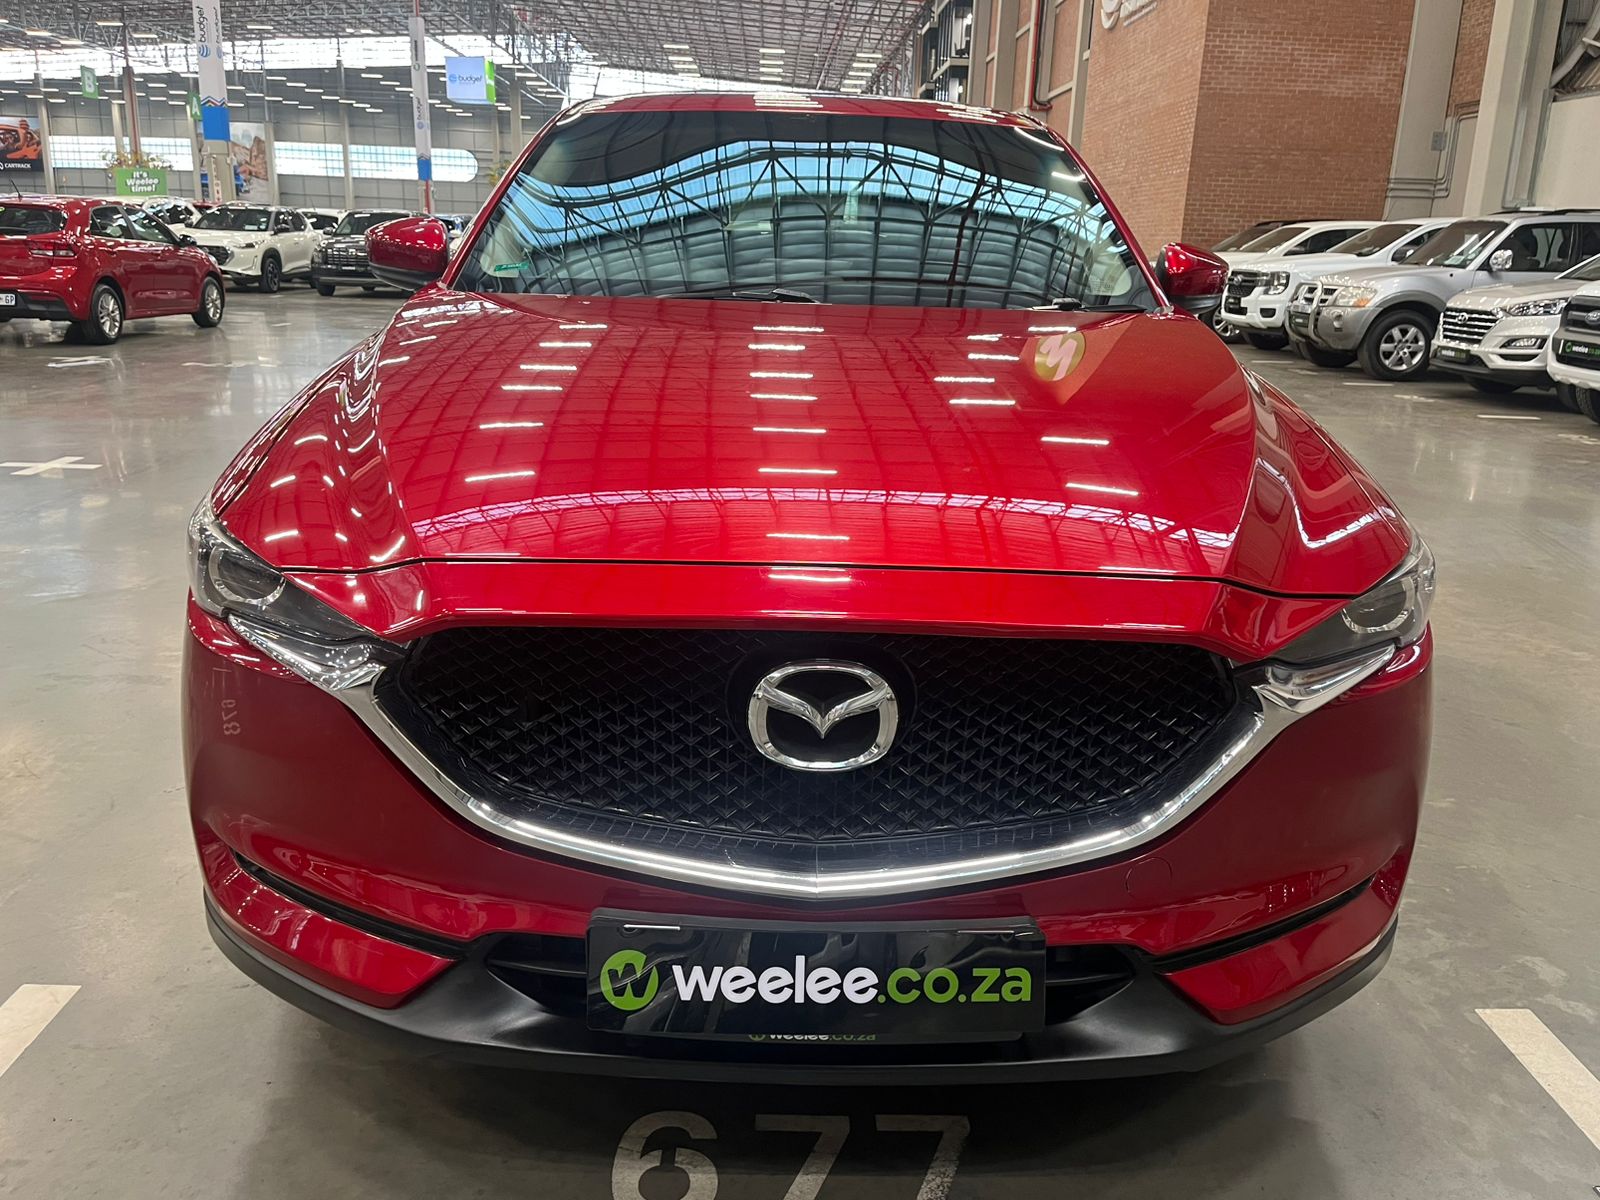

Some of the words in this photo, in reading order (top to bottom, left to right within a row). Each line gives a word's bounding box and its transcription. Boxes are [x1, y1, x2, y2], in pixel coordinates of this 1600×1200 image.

[195, 6, 208, 42] budget
[85, 70, 95, 93] B
[458, 74, 482, 84] budget
[191, 96, 200, 115] A
[131, 184, 156, 192] time!
[5, 295, 15, 304] GP
[672, 955, 1032, 1005] weelee.co.za
[611, 1110, 971, 1200] 677
